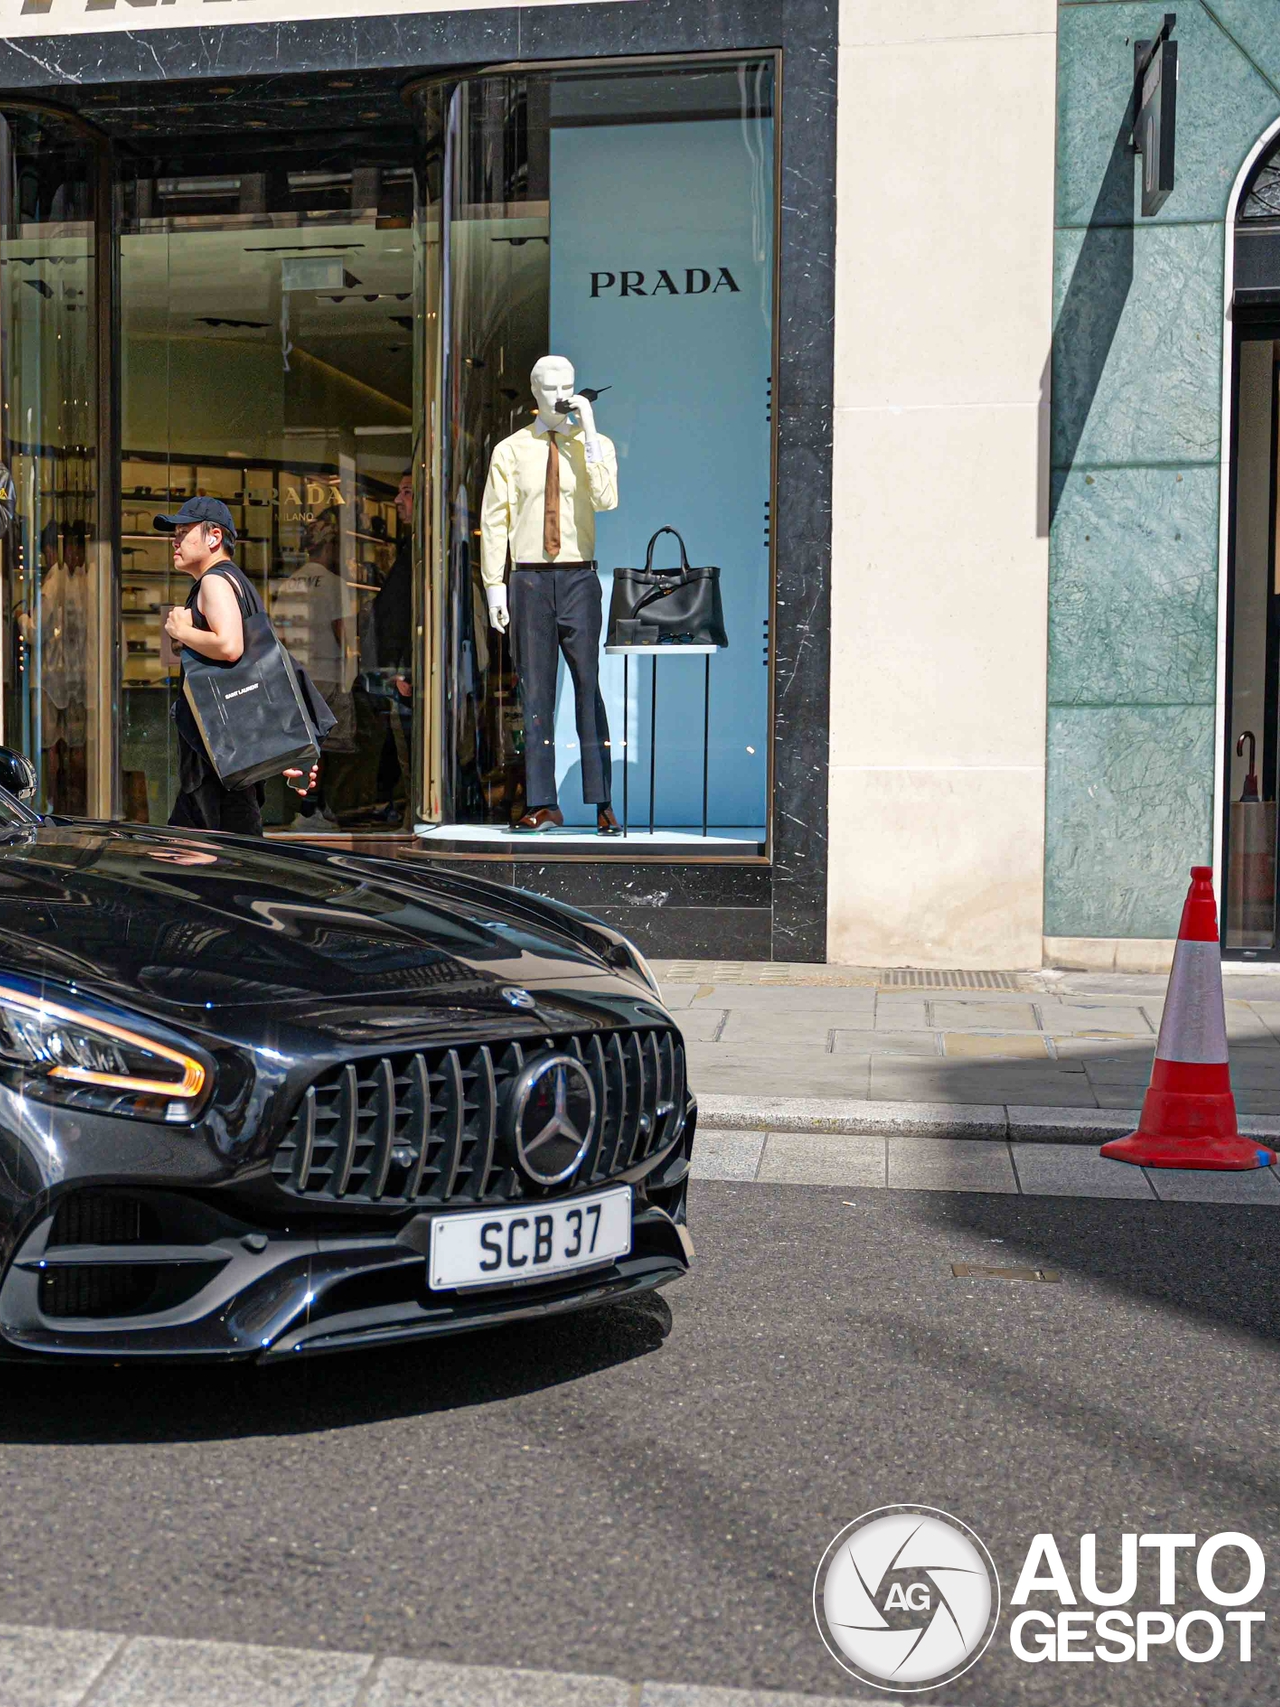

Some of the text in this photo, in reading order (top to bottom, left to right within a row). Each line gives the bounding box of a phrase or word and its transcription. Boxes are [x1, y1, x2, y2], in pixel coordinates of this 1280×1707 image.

[588, 267, 742, 298] PRADA
[243, 483, 346, 506] PRADA
[479, 1204, 602, 1272] SCB 37
